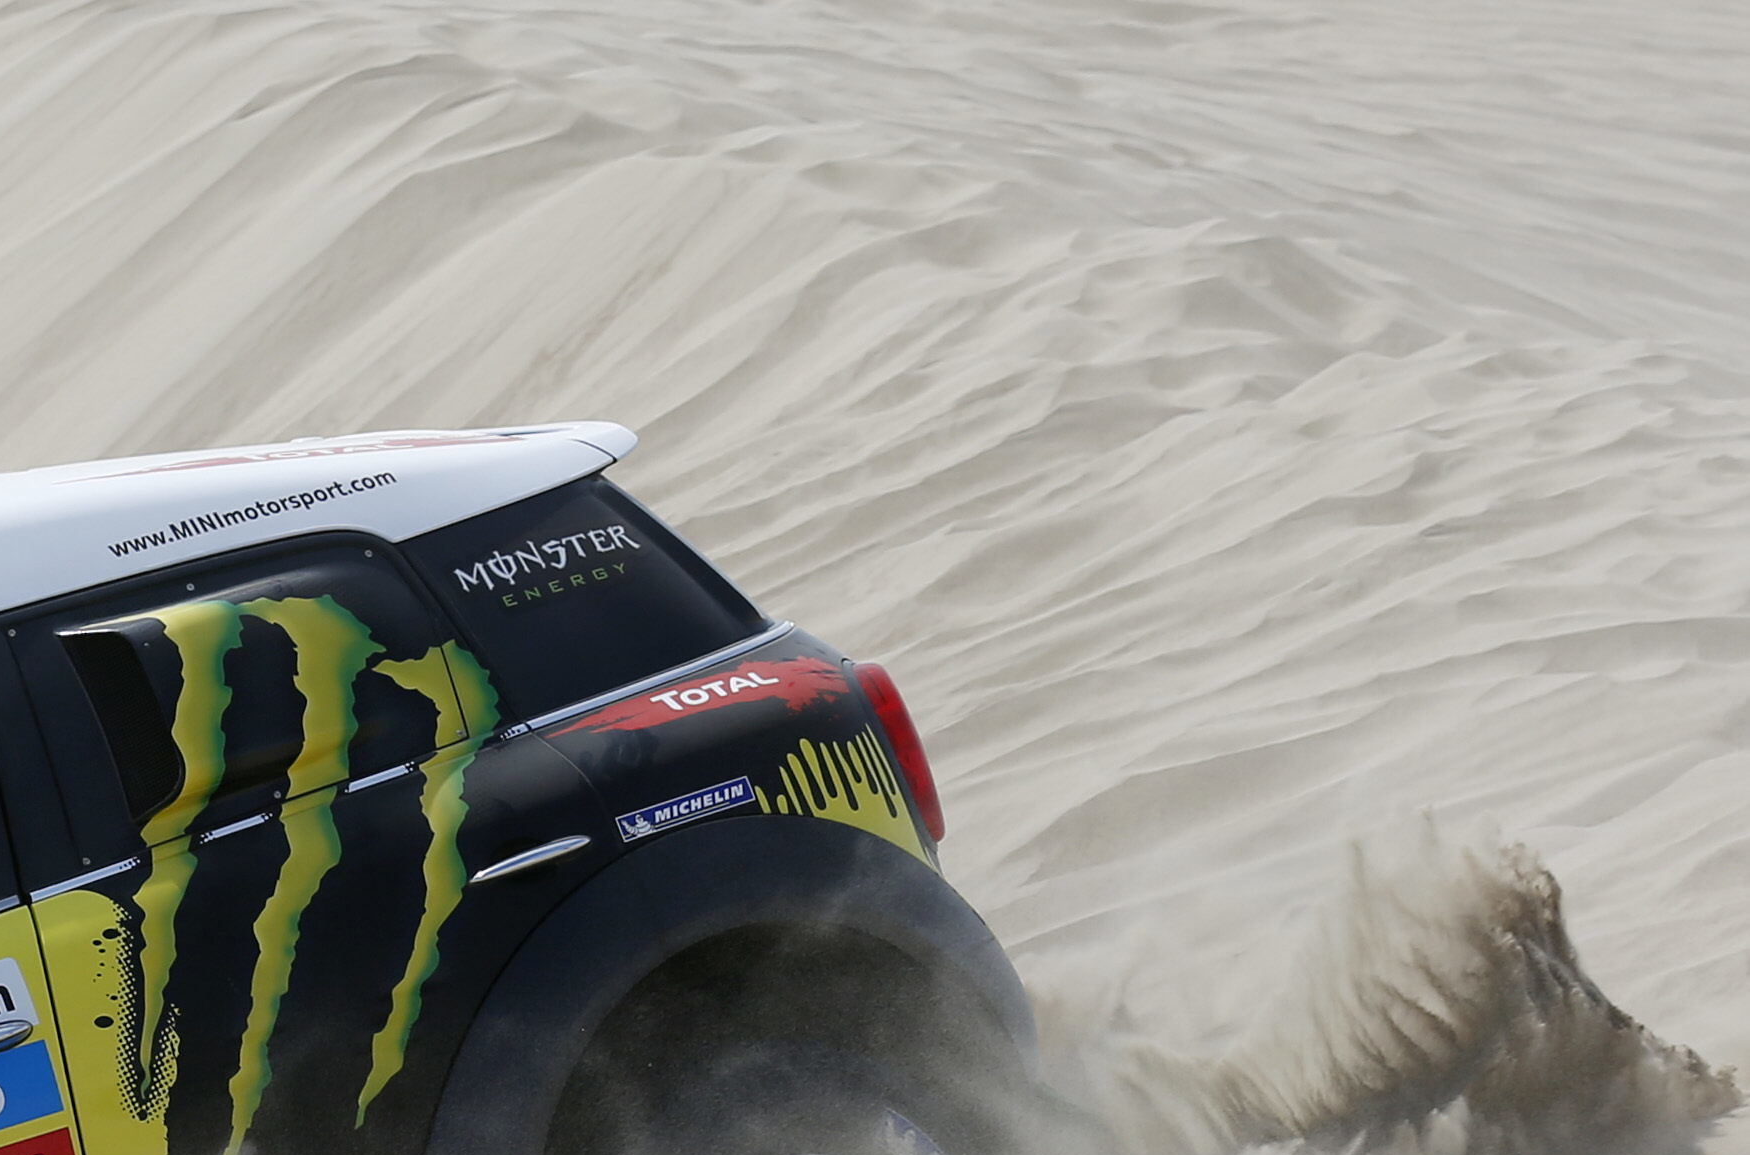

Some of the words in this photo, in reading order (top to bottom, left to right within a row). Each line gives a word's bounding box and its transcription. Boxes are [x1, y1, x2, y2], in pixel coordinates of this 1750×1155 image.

[108, 470, 397, 558] www.MINImotorsport.com
[453, 524, 641, 592] MONSTER
[502, 563, 626, 608] ENERGY
[650, 671, 780, 711] TOTAL
[654, 783, 745, 824] MICHELIN
